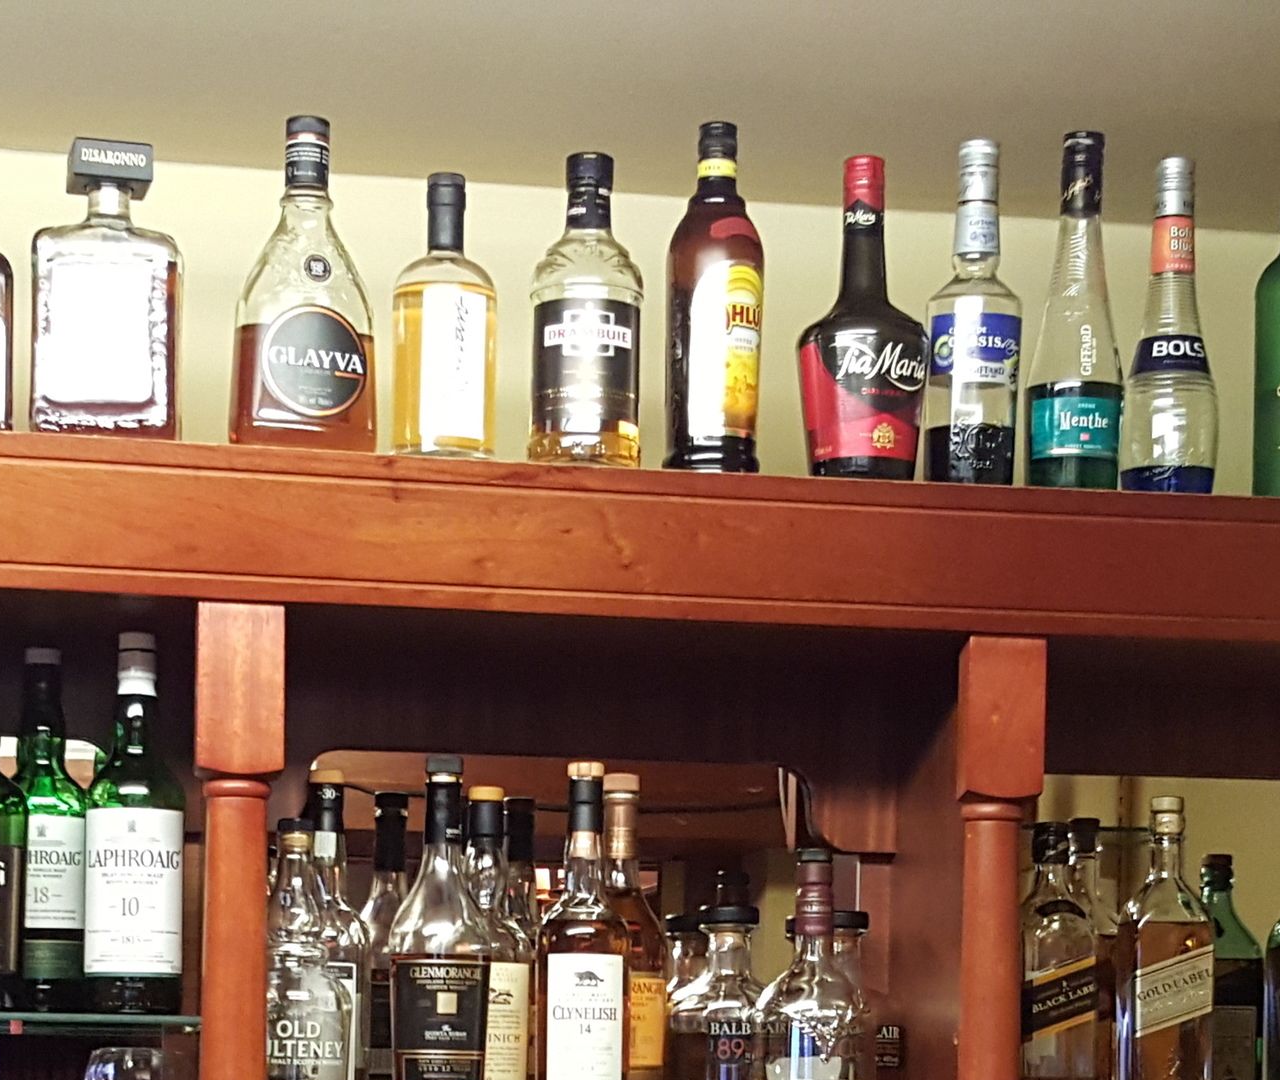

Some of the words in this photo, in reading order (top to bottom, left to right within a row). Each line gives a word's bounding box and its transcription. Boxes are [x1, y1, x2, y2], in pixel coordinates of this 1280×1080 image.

[80, 148, 147, 167] DISARONNO
[549, 328, 628, 343] DRABUIE
[1080, 325, 1093, 376] GIFFARD
[1151, 340, 1205, 359] BOLS
[269, 346, 364, 374] GLAYVA
[830, 339, 871, 381] Tia
[872, 344, 925, 390] Maria
[1060, 411, 1108, 431] Menthe
[322, 788, 335, 800] 30
[88, 849, 181, 871] LAPHROAIG
[31, 886, 49, 904] 18
[120, 896, 140, 917] 10
[1136, 982, 1172, 1002] GOLD
[1172, 969, 1215, 993] LABEL
[552, 1005, 617, 1021] CLYNELISH
[1032, 993, 1066, 1014] BLACK
[276, 1020, 320, 1038] OLD
[579, 1024, 593, 1035] 14
